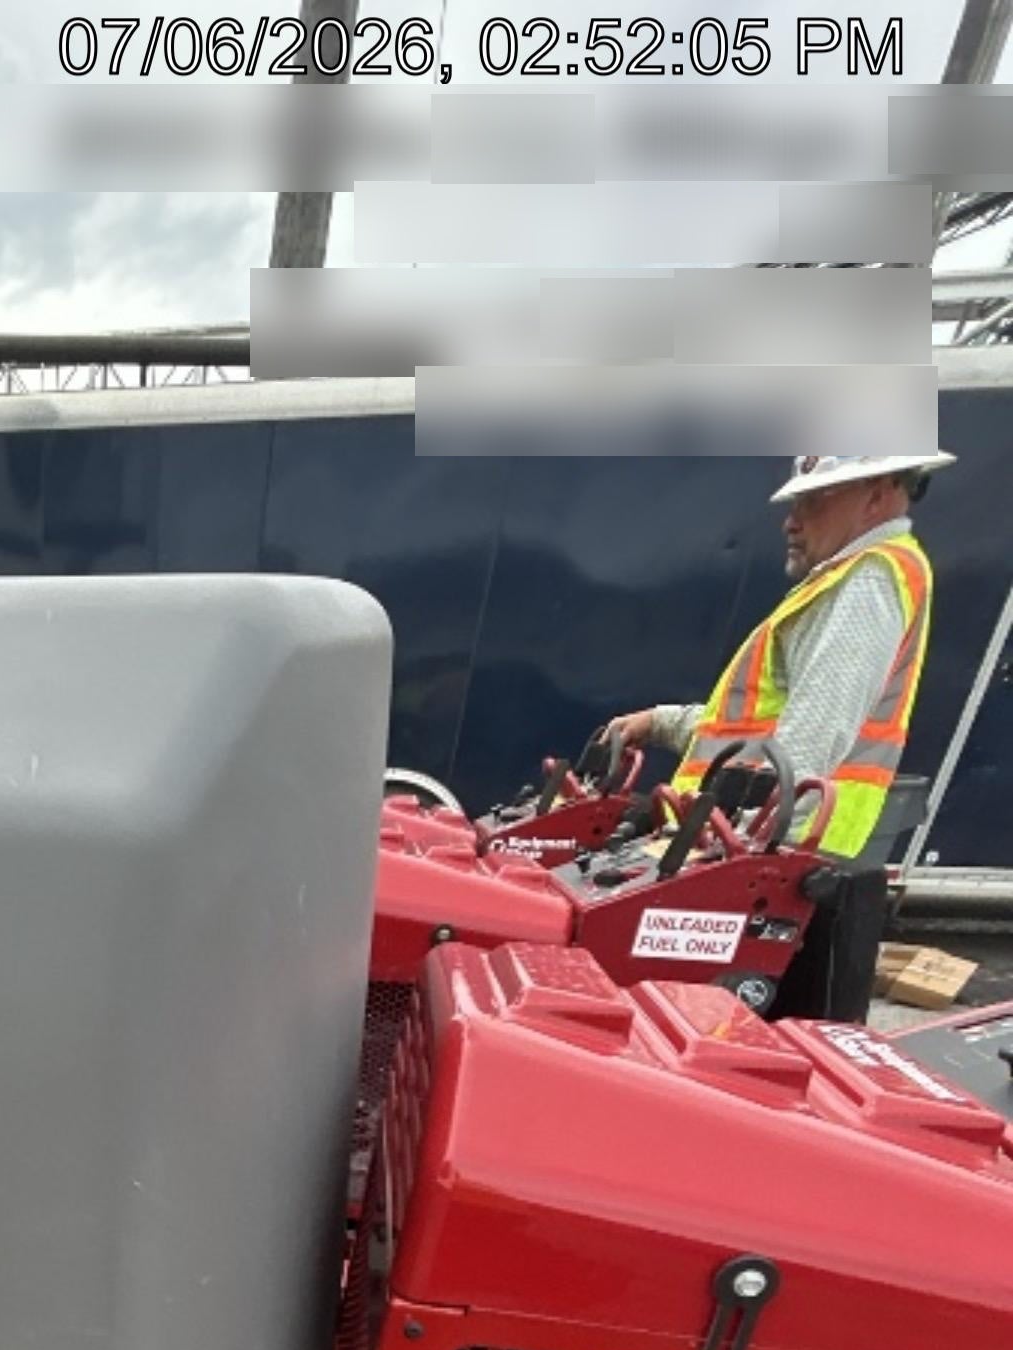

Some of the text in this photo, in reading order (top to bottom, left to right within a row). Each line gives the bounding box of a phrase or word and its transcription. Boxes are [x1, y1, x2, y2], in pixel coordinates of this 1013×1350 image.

[644, 913, 738, 934] UNLEADED
[637, 935, 732, 955] FUEL ONLY
